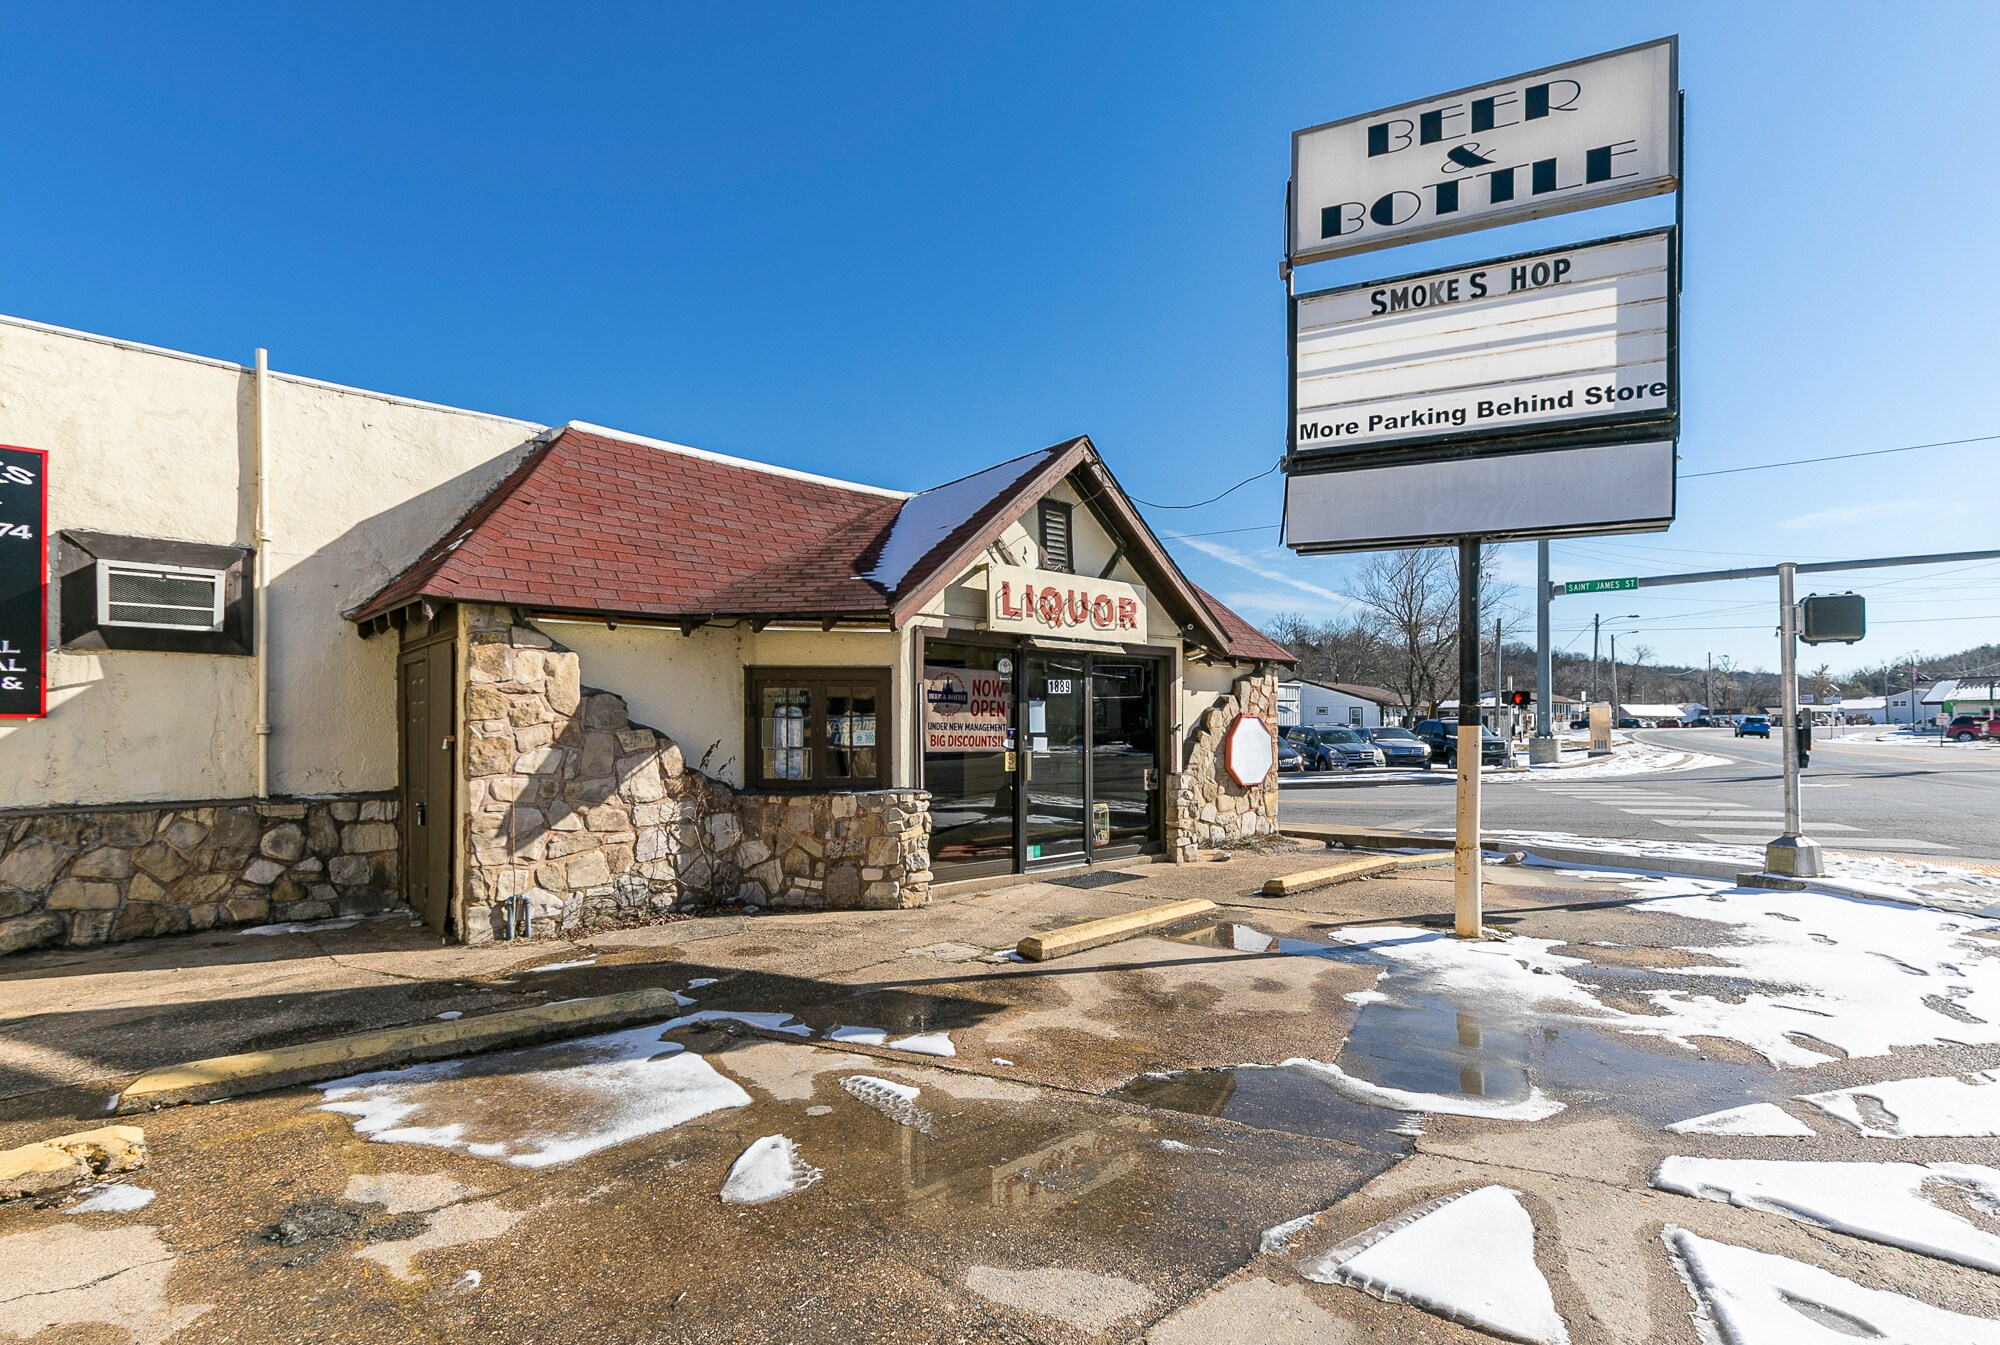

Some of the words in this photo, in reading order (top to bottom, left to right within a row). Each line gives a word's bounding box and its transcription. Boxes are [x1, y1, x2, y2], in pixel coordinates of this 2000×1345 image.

[1367, 79, 1582, 159] BEER
[1440, 142, 1497, 174] &
[1320, 139, 1640, 240] BOTTLE
[1510, 257, 1571, 291] HOP
[1299, 421, 1360, 441] More
[1368, 407, 1467, 432] Parking
[1476, 389, 1574, 419] Behind
[1583, 381, 1668, 407] Store
[0, 460, 37, 486] S
[1568, 582, 1590, 592] SAINT
[1595, 581, 1620, 590] JAMES
[1625, 579, 1636, 588] ST
[1001, 581, 1138, 629] LIQUOR
[971, 678, 1004, 698] NOW
[1049, 680, 1071, 693] 1889
[970, 700, 1006, 718] OPEN
[927, 722, 949, 731] UNDER
[949, 722, 964, 732] NEW
[964, 723, 1007, 732] MANAGEMENT
[930, 734, 946, 747] BIG
